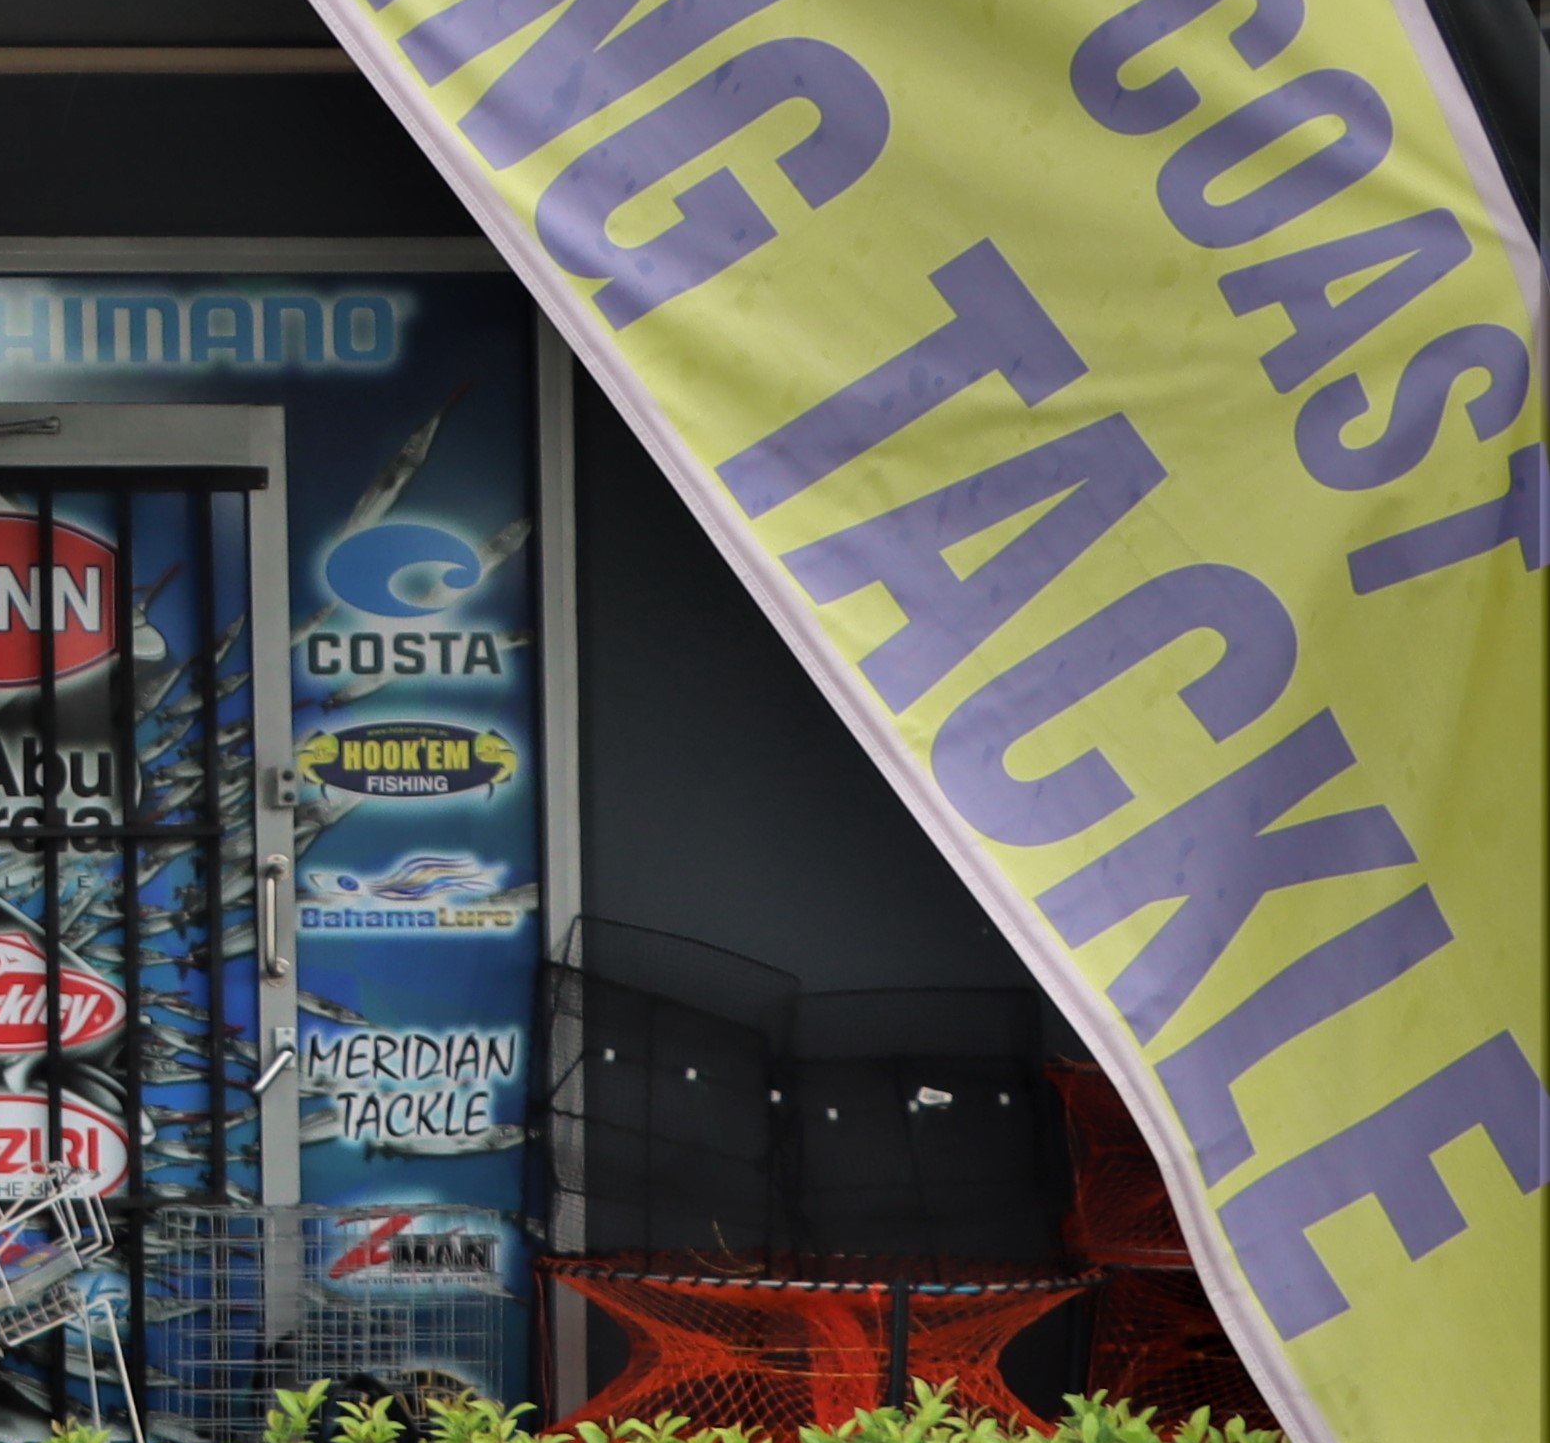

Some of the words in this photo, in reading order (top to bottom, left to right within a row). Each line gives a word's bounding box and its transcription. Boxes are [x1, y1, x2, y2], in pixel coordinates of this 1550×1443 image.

[305, 631, 503, 677] COSTA
[343, 736, 470, 771] HOOK'EM
[366, 775, 449, 793] FISHING
[715, 238, 1550, 1343] TACKLE
[305, 1032, 518, 1080] MERIDIAN
[336, 1089, 491, 1141] TACKLE
